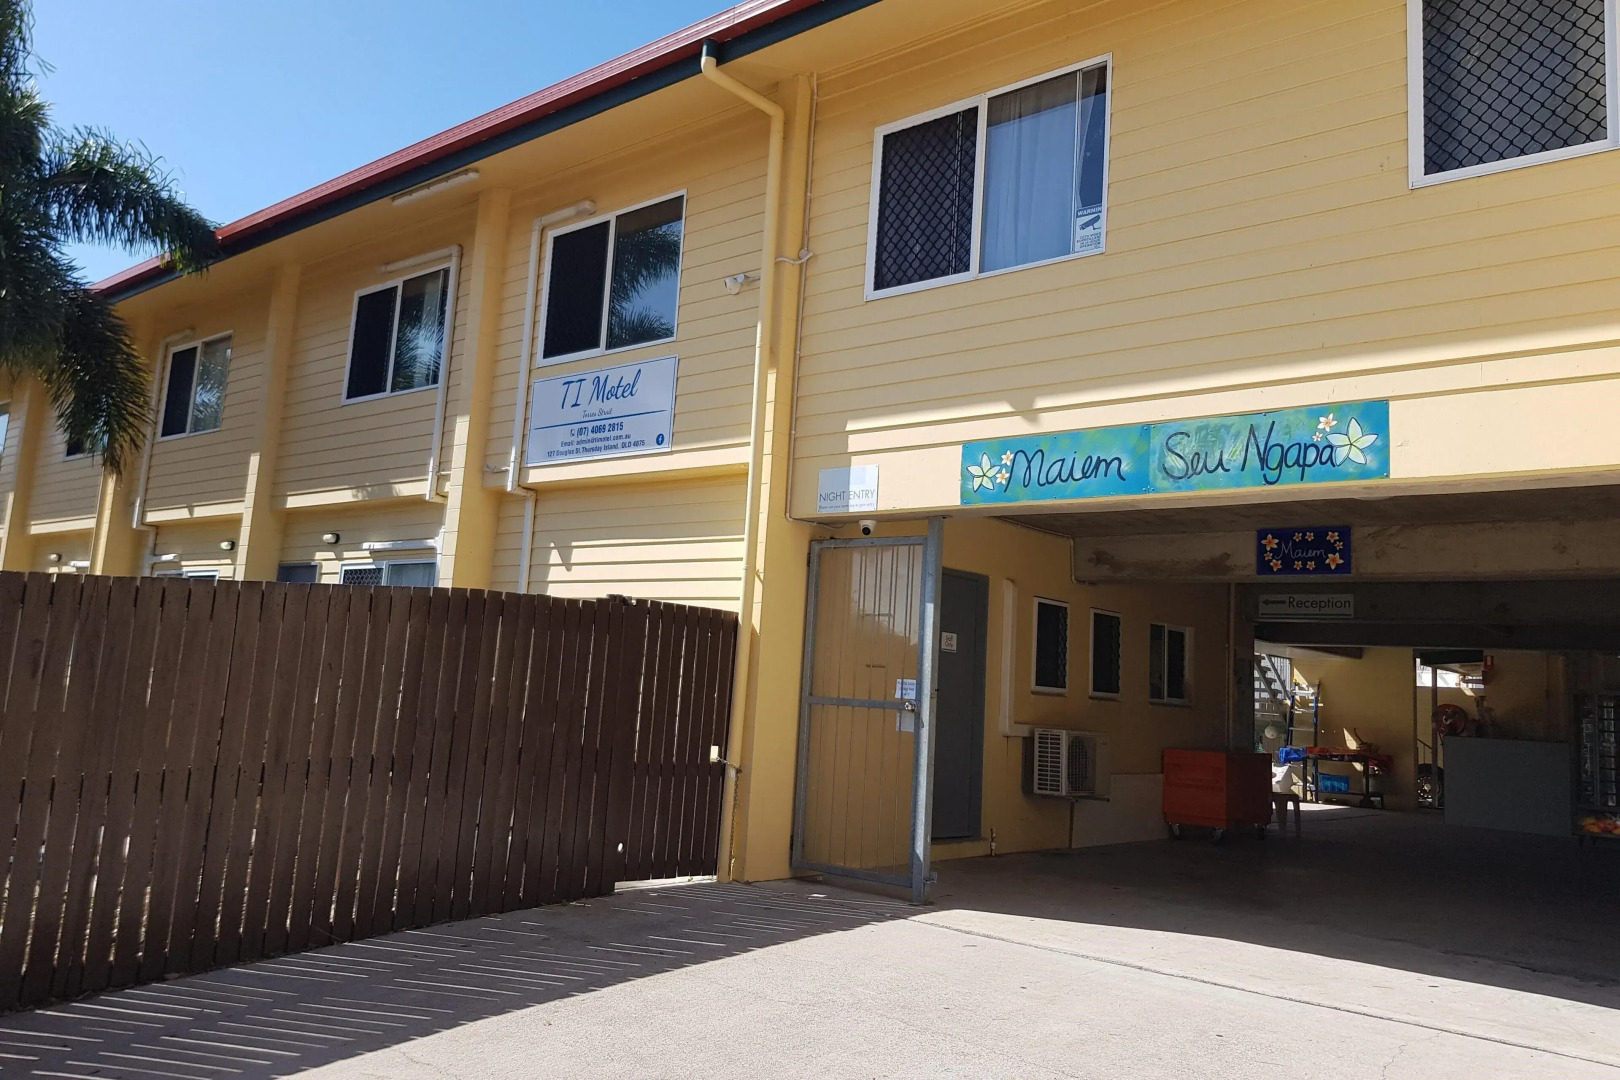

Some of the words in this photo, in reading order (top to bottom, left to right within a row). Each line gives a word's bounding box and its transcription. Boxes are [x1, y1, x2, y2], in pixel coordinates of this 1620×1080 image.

[1078, 206, 1102, 215] WARNIN
[561, 378, 587, 409] TI
[588, 368, 642, 405] Motel
[576, 426, 589, 438] (07)
[590, 424, 606, 434] 4069
[607, 421, 624, 433] 2815
[547, 450, 555, 458] 127
[556, 448, 575, 457] Douglas
[582, 445, 603, 453] Thursday
[621, 441, 632, 449] QLD
[1004, 449, 1126, 493] Maiem
[1161, 431, 1231, 481] Seu
[1240, 420, 1339, 485] Ngapa
[819, 491, 846, 502] NIGHT
[849, 489, 876, 500] ENTRY
[1274, 540, 1326, 559] Maiem
[1288, 596, 1351, 611] Reception
